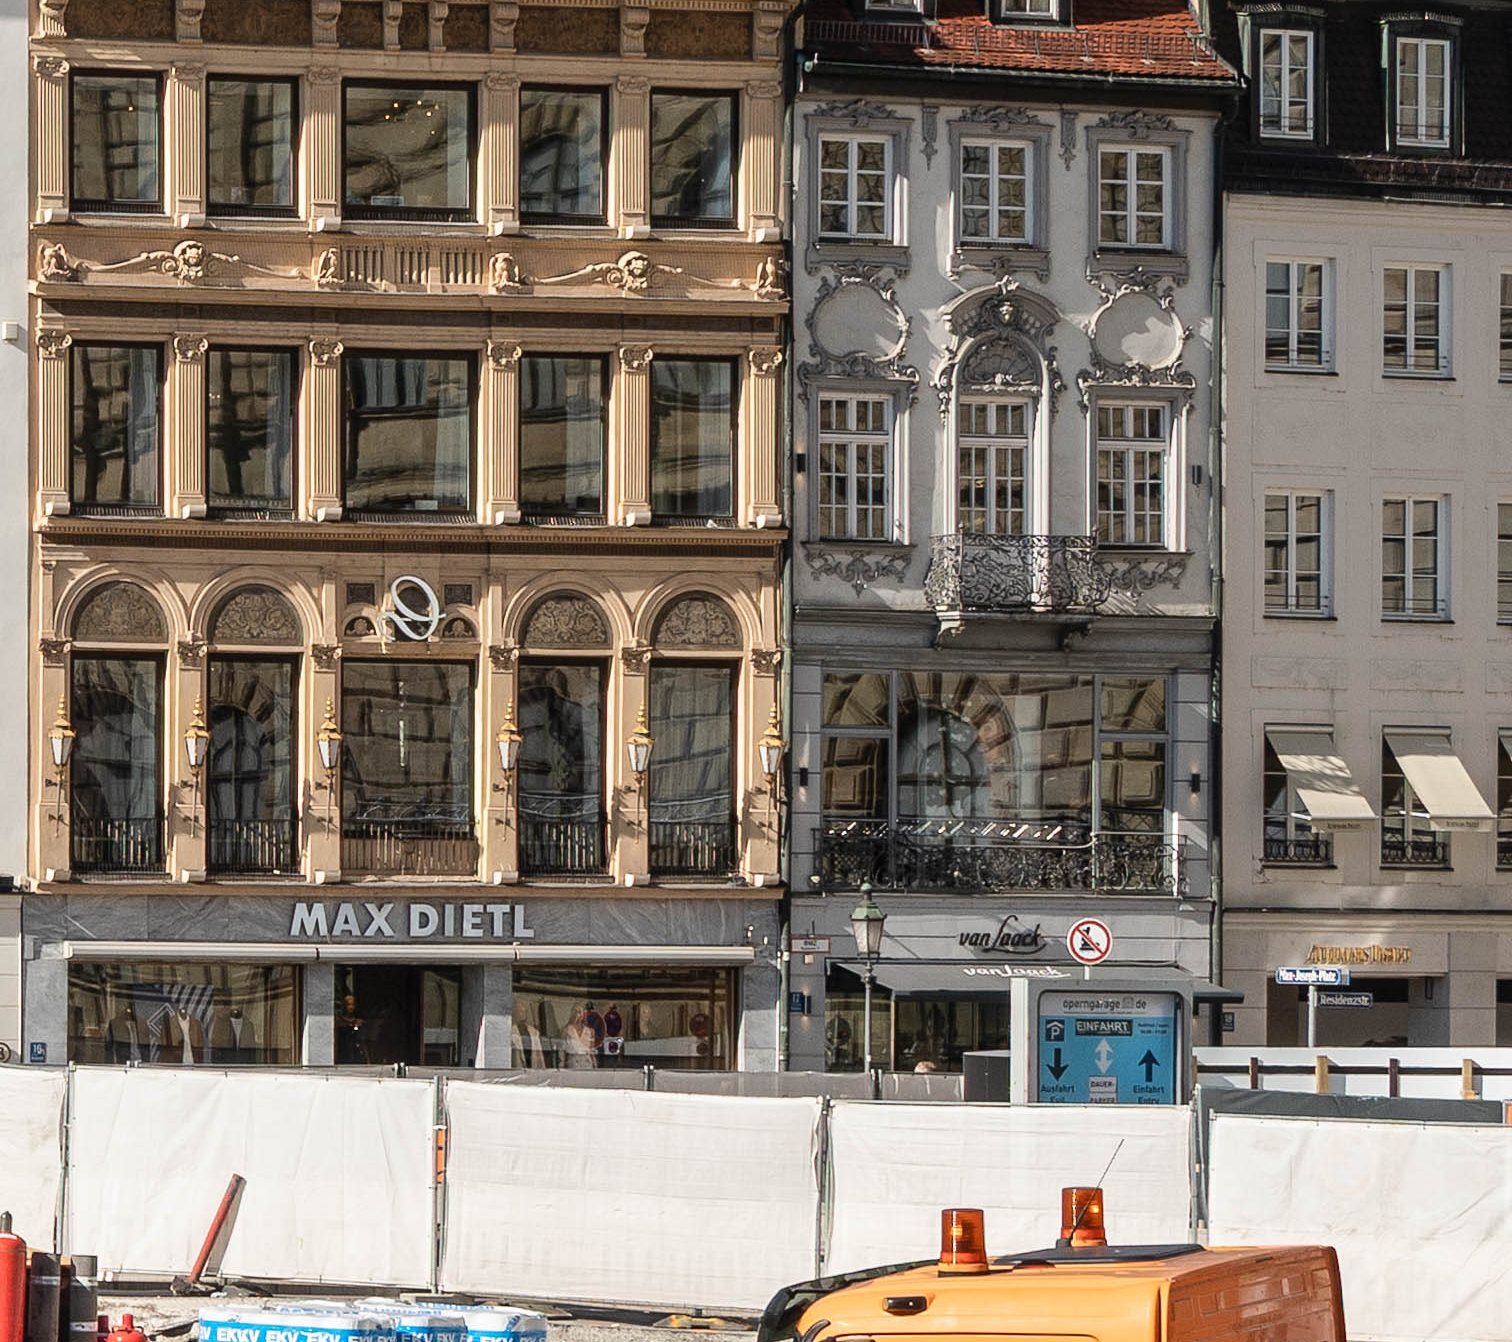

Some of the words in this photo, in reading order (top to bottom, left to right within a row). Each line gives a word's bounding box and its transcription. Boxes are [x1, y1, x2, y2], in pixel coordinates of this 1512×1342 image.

[290, 903, 395, 937] MAX
[409, 904, 536, 938] DIETL
[1063, 1000, 1120, 1012] operngarage
[1076, 1021, 1129, 1032] EINFAHRT
